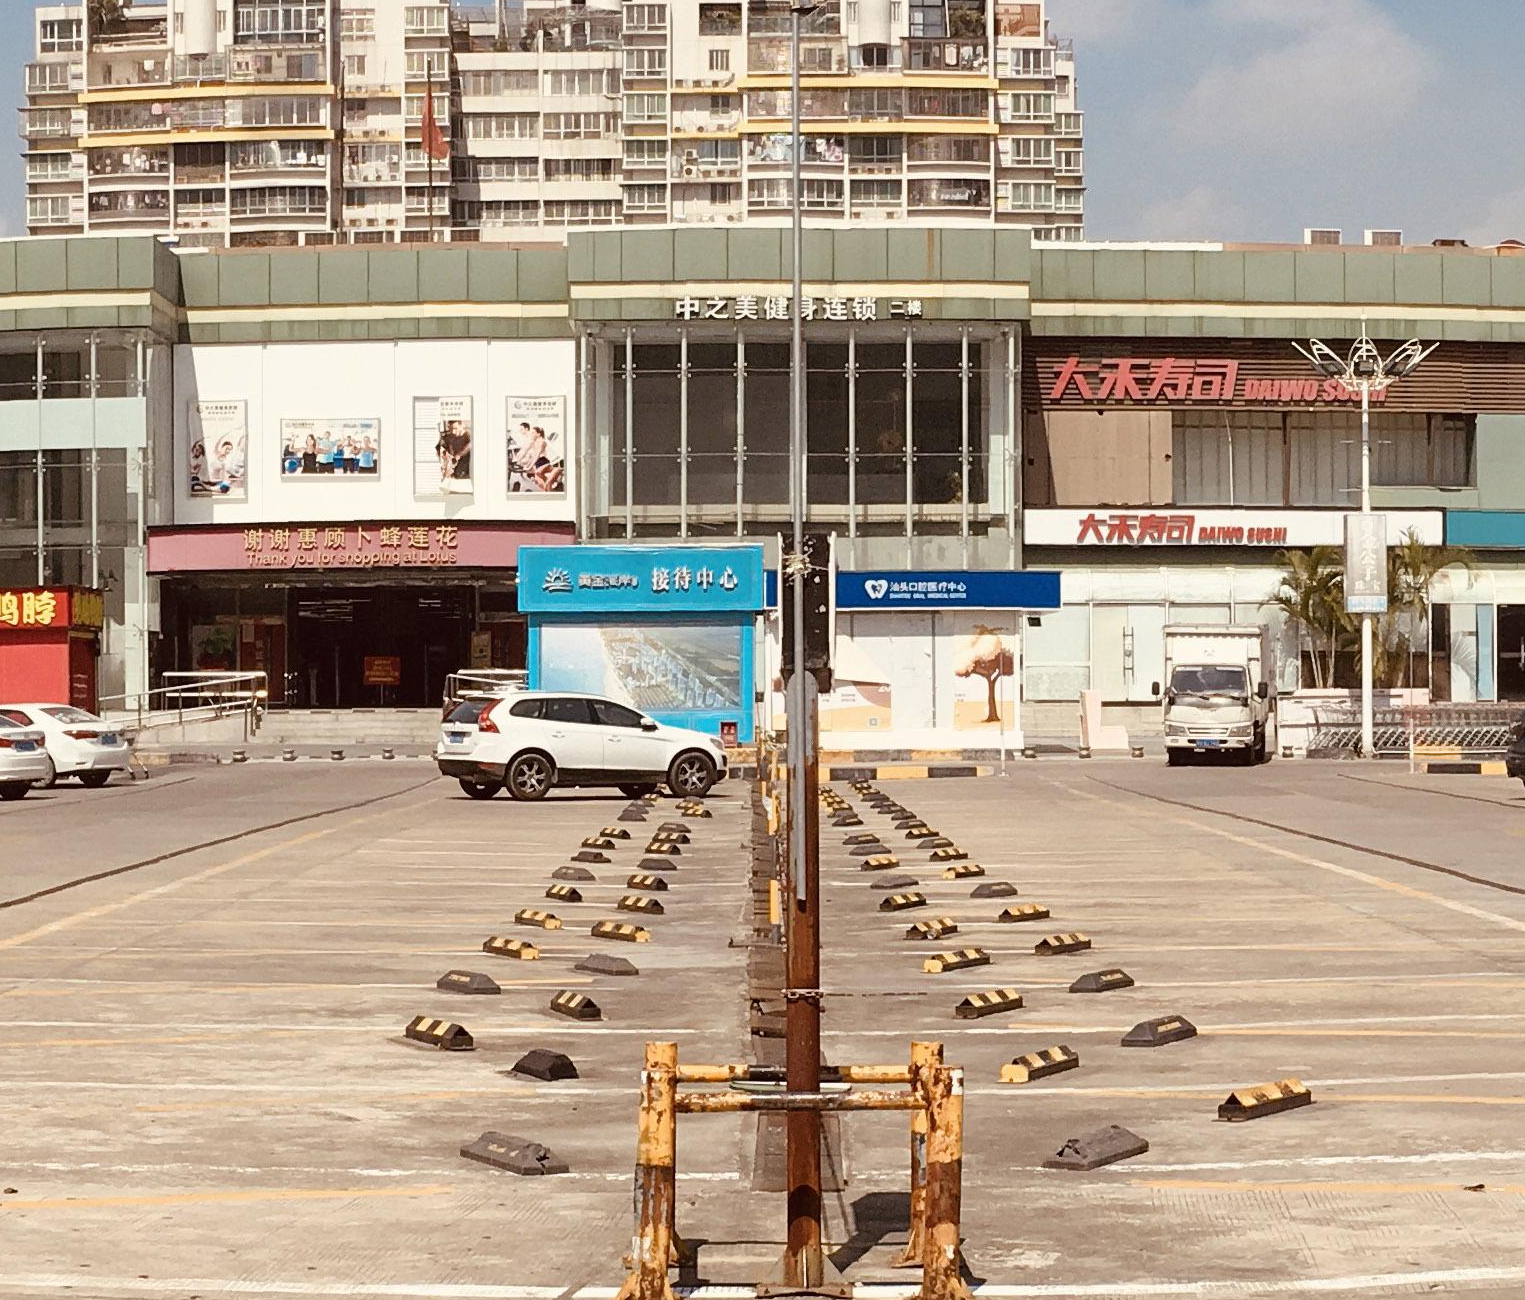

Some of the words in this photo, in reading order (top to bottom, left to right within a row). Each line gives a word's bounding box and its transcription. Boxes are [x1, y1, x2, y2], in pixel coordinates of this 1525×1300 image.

[675, 295, 877, 321] 中之美健身连锁
[890, 300, 923, 316] 二楼
[1052, 356, 1239, 400] 大禾寿司
[1245, 378, 1317, 401] DAIWO
[243, 525, 458, 550] 谢谢惠顾卜蜂莲花
[1077, 513, 1195, 545] 大禾寿司
[1198, 526, 1244, 544] DAIWO
[248, 553, 288, 565] Thank
[291, 555, 315, 569] you
[318, 552, 336, 565] for
[338, 551, 400, 568] shopping
[404, 552, 418, 565] at
[420, 550, 457, 564] Lotus
[652, 565, 739, 591] 接待中心
